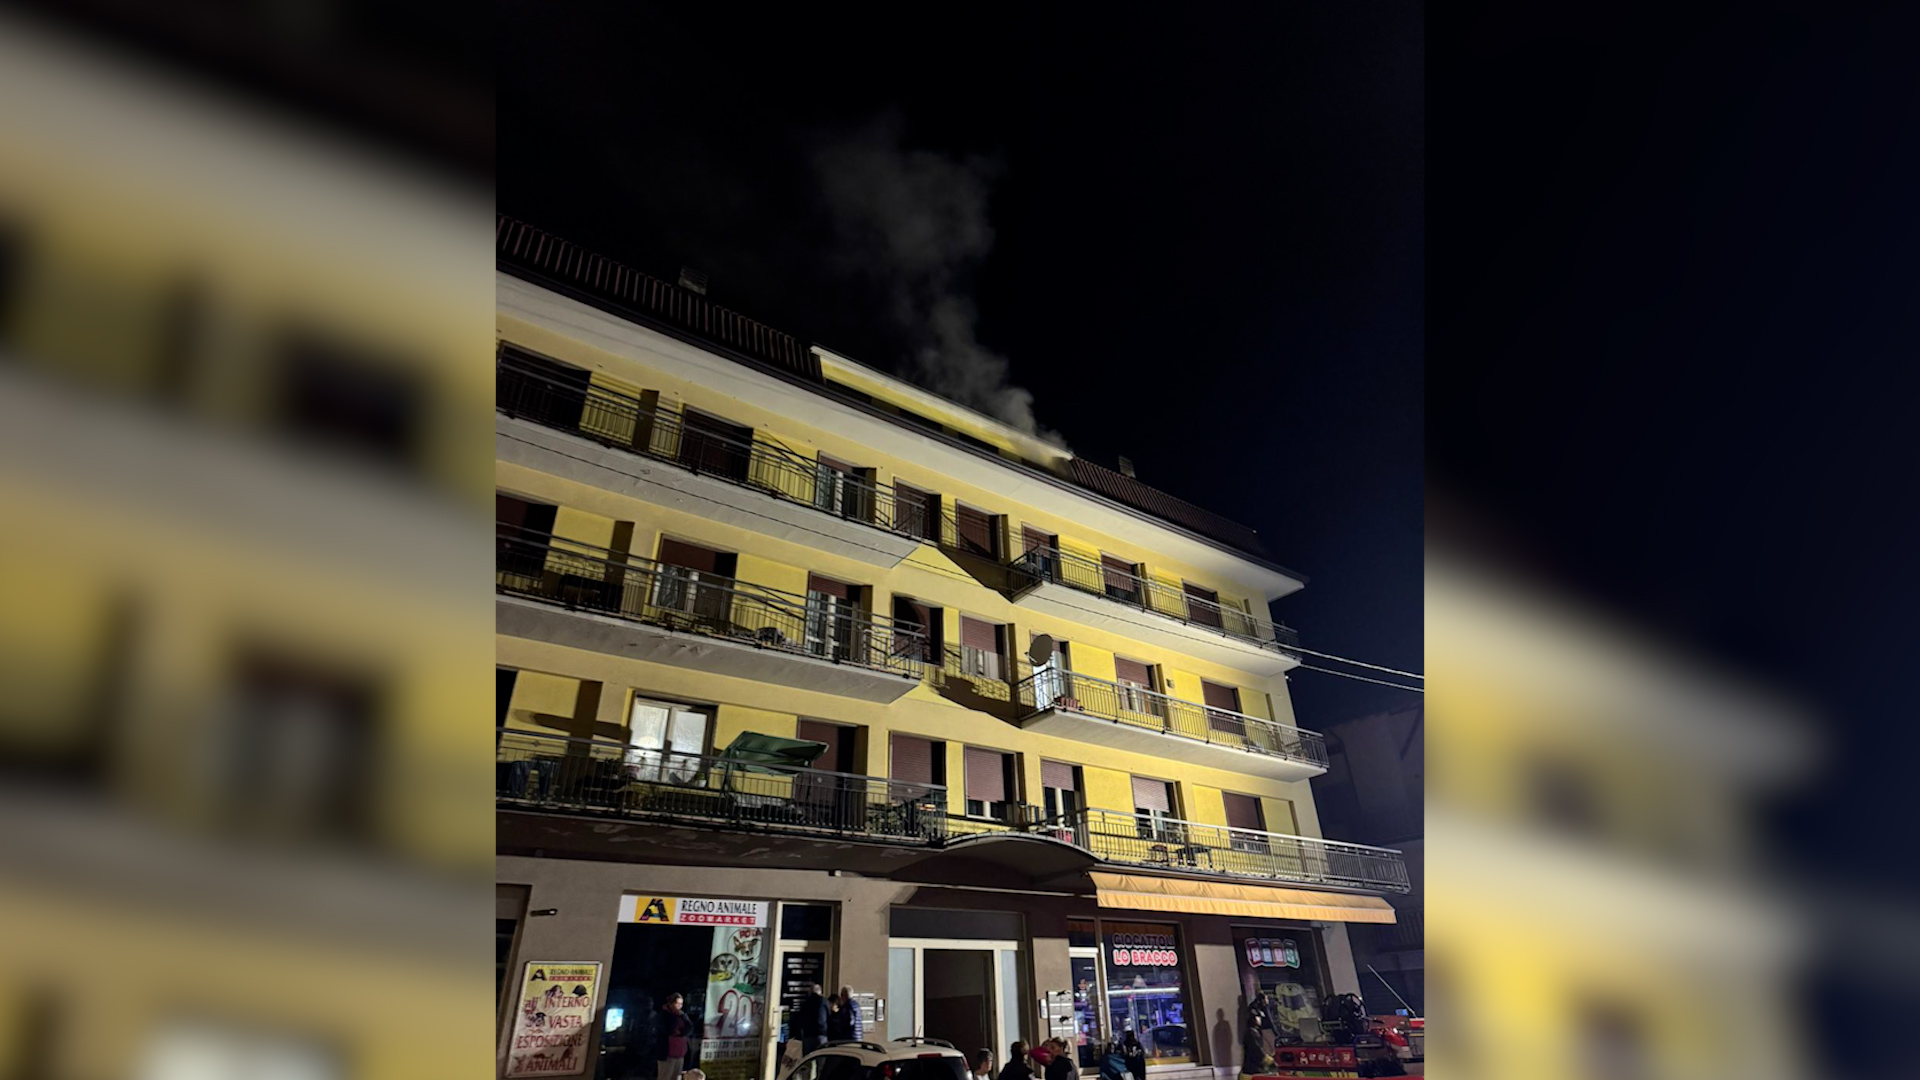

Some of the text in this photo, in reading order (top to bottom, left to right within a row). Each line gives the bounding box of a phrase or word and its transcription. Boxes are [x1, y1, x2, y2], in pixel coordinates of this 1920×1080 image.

[680, 900, 757, 914] REGNO ANIMALE
[680, 913, 756, 925] ZOOMARKET
[1112, 932, 1176, 949] GIOCATTOLI
[1113, 949, 1178, 966] LO BRACCO
[544, 996, 590, 1009] INTERNO
[548, 1015, 583, 1029] VASTA
[516, 1033, 583, 1049] ESPOSIZIONE
[526, 1056, 578, 1072] ANIMALI
